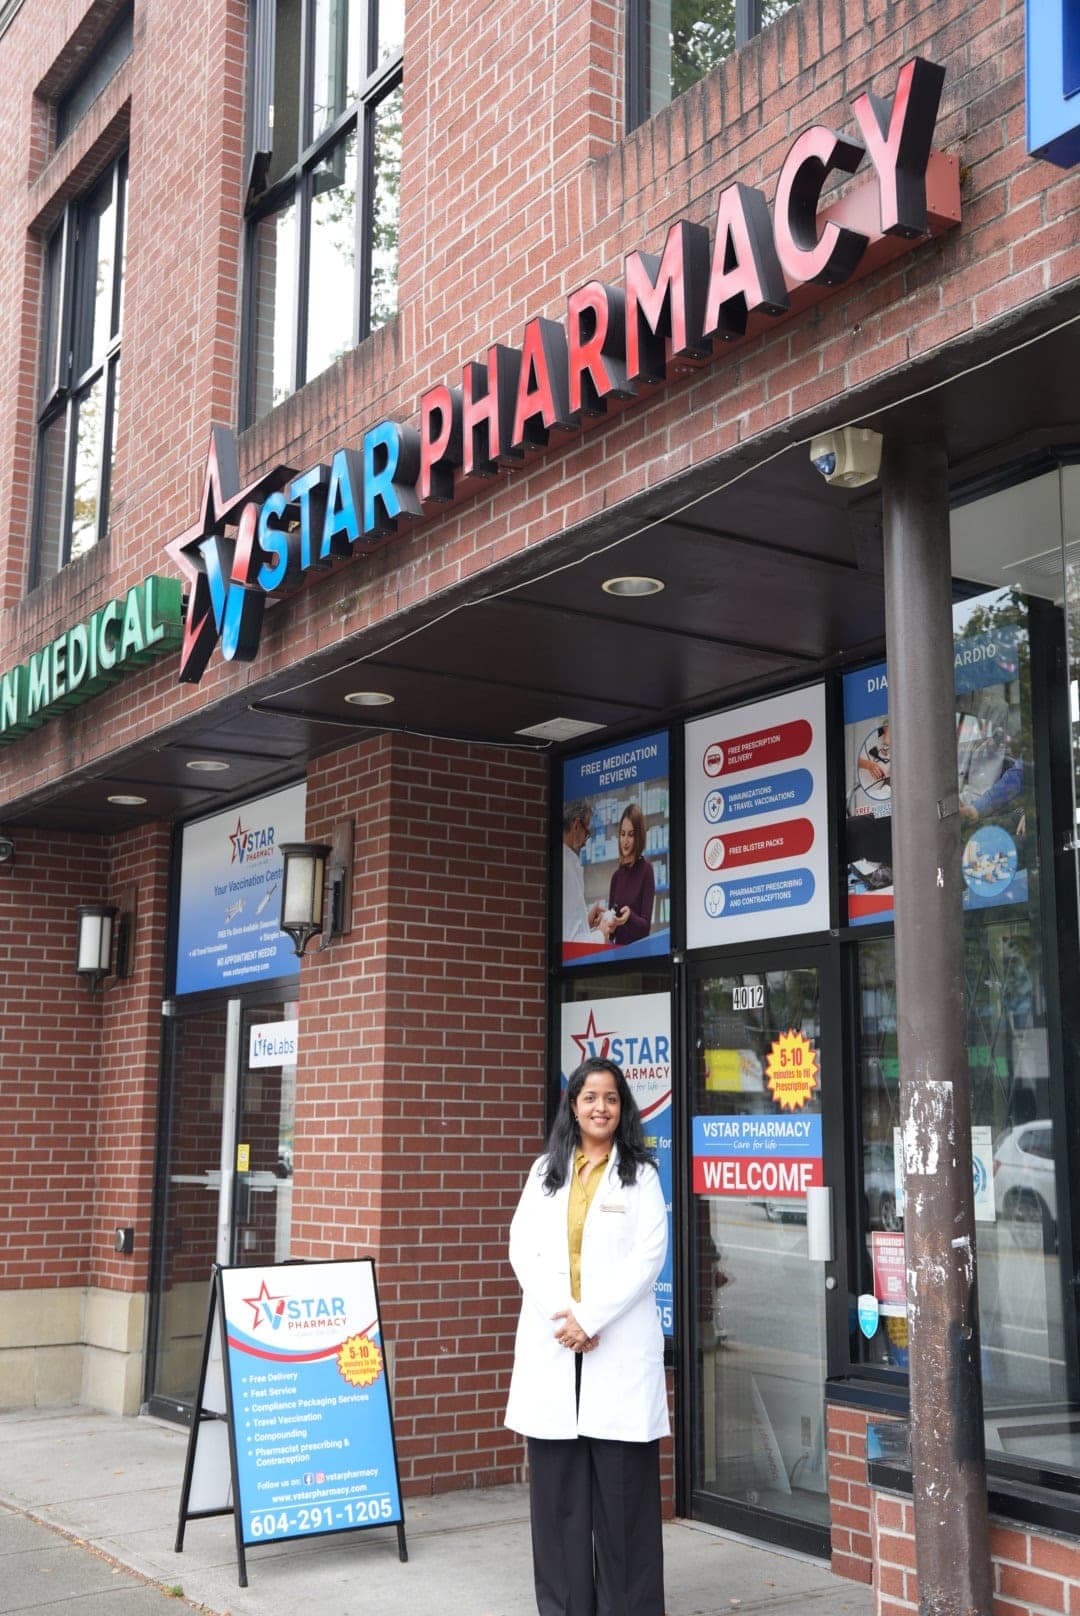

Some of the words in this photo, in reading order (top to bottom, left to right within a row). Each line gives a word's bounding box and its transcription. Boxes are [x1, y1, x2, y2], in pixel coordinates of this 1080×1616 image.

[420, 57, 922, 499] PHARMACY
[28, 577, 165, 717] MEDICAL
[954, 643, 997, 667] ARDIO
[728, 746, 741, 755] FREE
[741, 735, 781, 751] PRESCRIPTION
[580, 760, 601, 777] FREE
[602, 745, 658, 771] MEDICATION
[728, 752, 753, 765] DELIVERY
[599, 765, 637, 786] REVIEWS
[728, 786, 772, 802] IMMUNIZATIONS
[733, 800, 754, 812] TRAVEL
[754, 790, 795, 806] VACCINATIONS
[237, 826, 275, 864] VSTAR
[729, 847, 742, 856] FREE
[743, 841, 765, 853] BLISTER
[766, 837, 784, 848] PACKS
[214, 884, 227, 896] Your
[228, 873, 265, 892] Vaccination
[729, 884, 765, 897] PHARMACIST
[766, 878, 803, 891] PRESCRIBING
[730, 899, 741, 908] AND
[742, 891, 792, 905] CONTRACEPTIONS
[225, 950, 258, 966] APPOINTMENT
[734, 987, 763, 1009] 4012
[254, 1032, 295, 1057] LifeLabs
[780, 1048, 802, 1067] 5-10
[625, 1067, 670, 1080] ARMACY
[773, 1071, 795, 1079] minutes
[796, 1070, 802, 1078] to
[776, 1082, 809, 1091] Prescription
[703, 1122, 740, 1137] VSTAR
[742, 1121, 811, 1137] PHARMACY
[733, 1140, 750, 1149] Care
[752, 1139, 763, 1152] for
[765, 1139, 778, 1150] life
[703, 1161, 813, 1192] WELCOME
[261, 1297, 346, 1331] VSTAR
[288, 1316, 347, 1331] PHARMACY
[349, 1346, 369, 1359] 5-10
[249, 1374, 266, 1383] Free
[268, 1372, 298, 1382] Delivery
[251, 1388, 267, 1397] Fast
[269, 1386, 296, 1395] Service
[252, 1401, 297, 1413] Compliance
[298, 1396, 337, 1407] Packaging
[338, 1394, 369, 1403] Services
[253, 1417, 277, 1427] Travel
[278, 1413, 322, 1424] Vaccination
[254, 1429, 308, 1442] Compounding
[255, 1444, 299, 1456] Pharmacist
[300, 1439, 342, 1453] prescribing
[256, 1454, 310, 1467] Contraception
[257, 1481, 279, 1490] Follow
[281, 1479, 290, 1487] us
[325, 1468, 379, 1481] vstarpharmacy
[272, 1484, 368, 1502] www.vstarpharmacy.com
[250, 1498, 393, 1537] 604-291-1205
